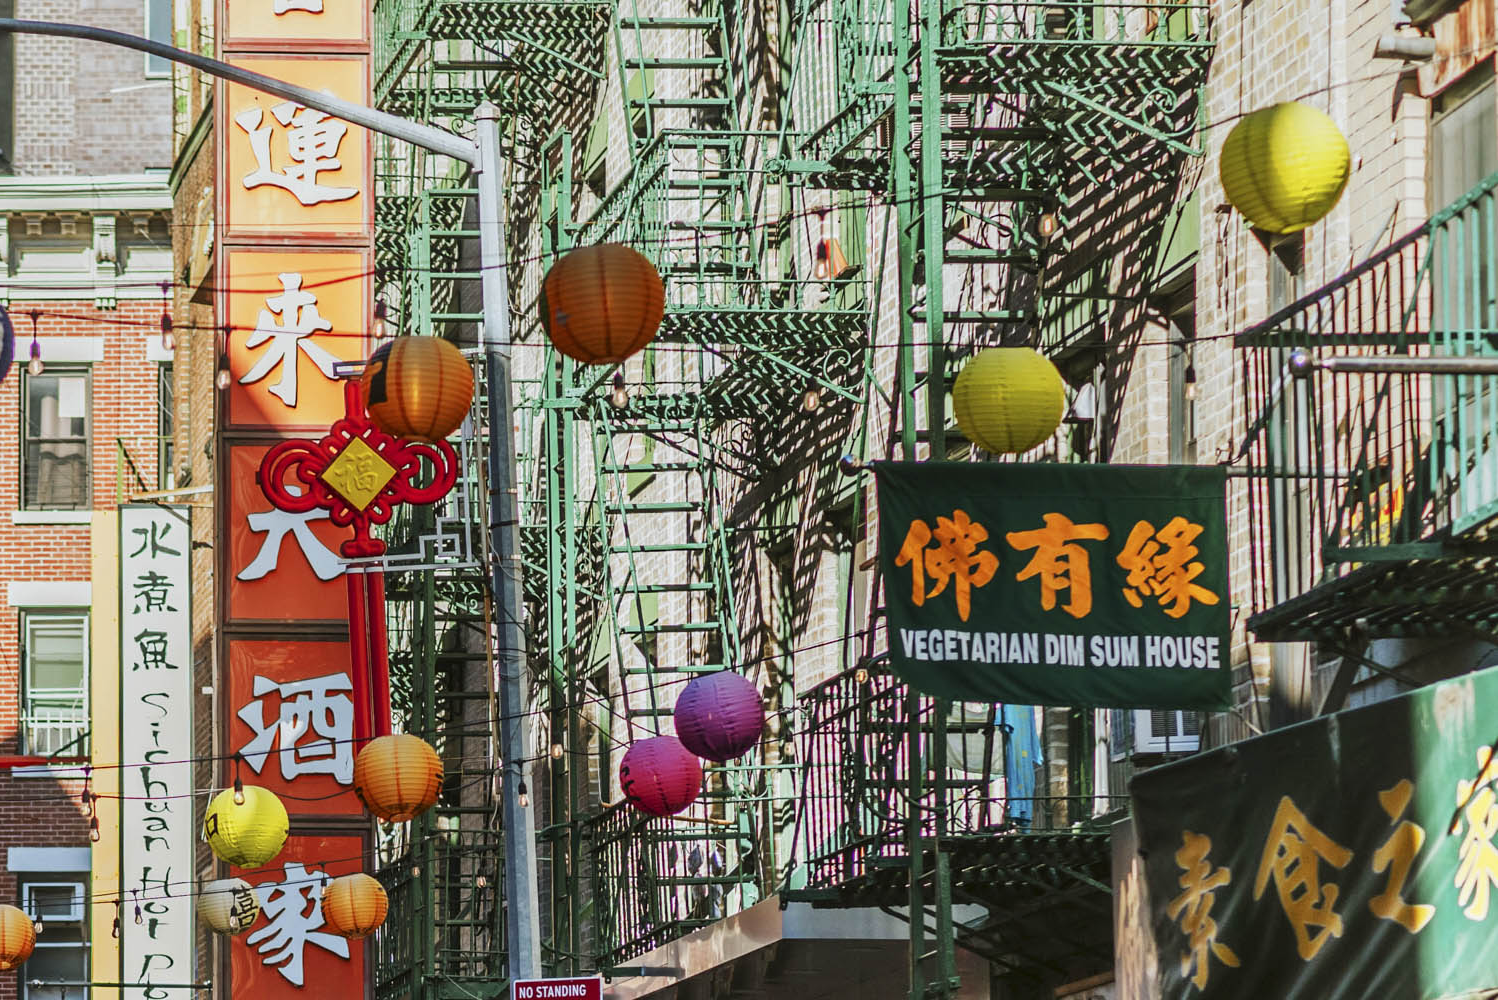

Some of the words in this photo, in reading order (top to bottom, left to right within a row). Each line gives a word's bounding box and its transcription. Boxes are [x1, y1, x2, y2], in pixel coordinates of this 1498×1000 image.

[235, 0, 361, 988] 運來大酒家
[129, 519, 182, 672] 水煮魚
[894, 508, 1222, 623] 佛有緣
[900, 628, 1040, 666] VEGETARIAN
[1044, 634, 1086, 667] DIM
[1090, 635, 1140, 669] SUM
[1144, 635, 1222, 670] HOUSE
[518, 986, 534, 999] NO
[536, 984, 587, 998] STANDING
